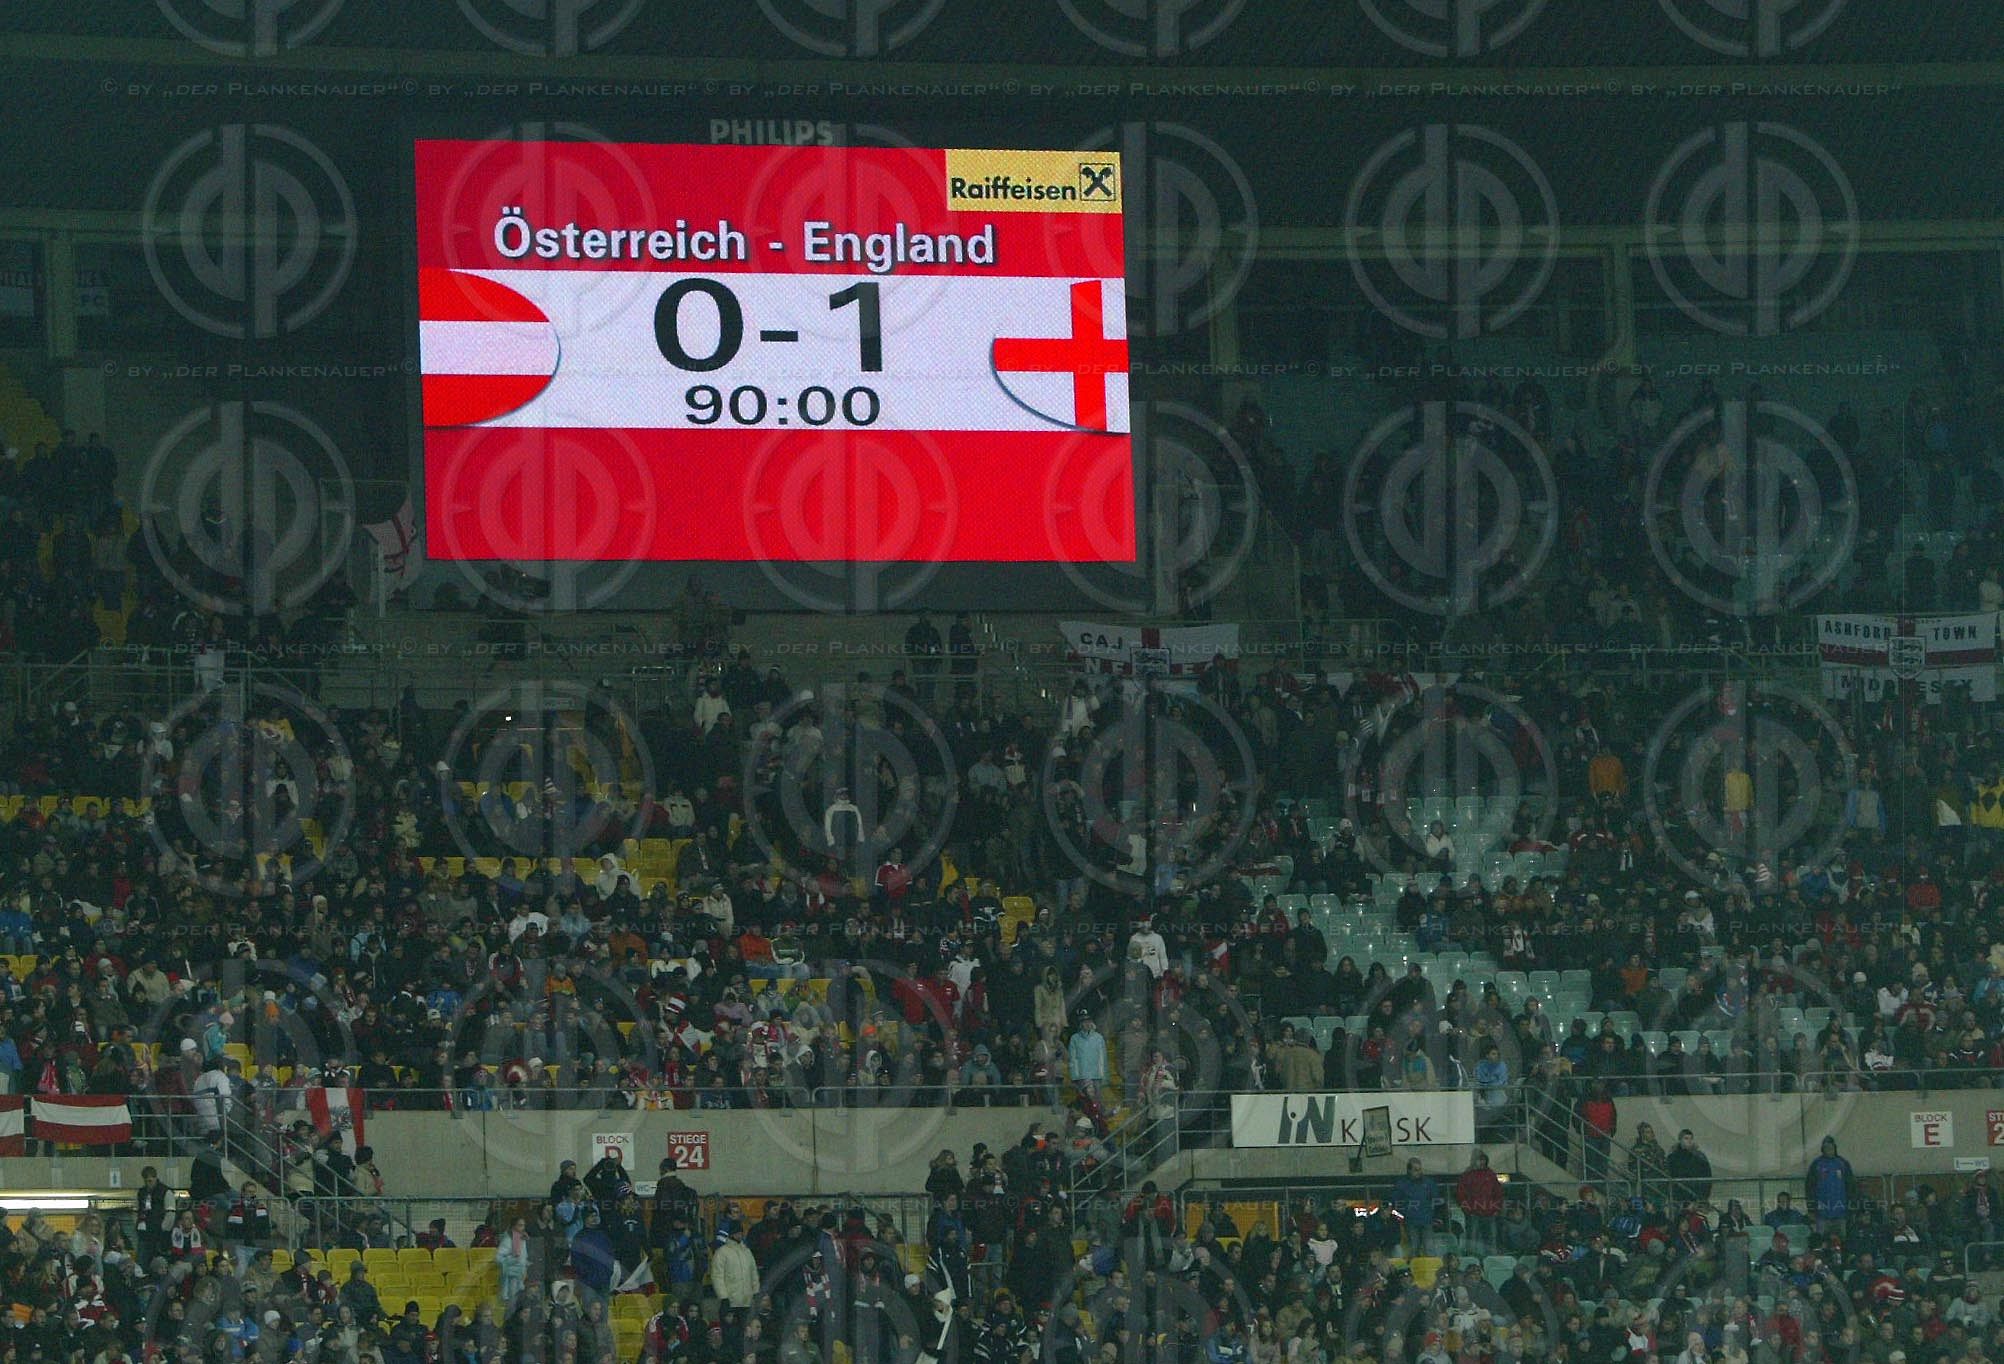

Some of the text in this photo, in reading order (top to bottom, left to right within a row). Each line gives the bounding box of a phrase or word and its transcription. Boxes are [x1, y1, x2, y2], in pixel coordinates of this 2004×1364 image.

[710, 119, 833, 145] PHILIPS
[951, 175, 1077, 200] Raiffeisen
[494, 207, 746, 260] Österreich
[803, 221, 994, 274] England
[685, 385, 880, 426] 90:00
[1933, 625, 1977, 641] TOWN
[1914, 1113, 1948, 1123] BLOCK
[596, 1135, 629, 1145] BLOCK
[669, 1134, 707, 1145] STIEGE
[1924, 1123, 1941, 1146] E
[674, 1145, 705, 1168] 24
